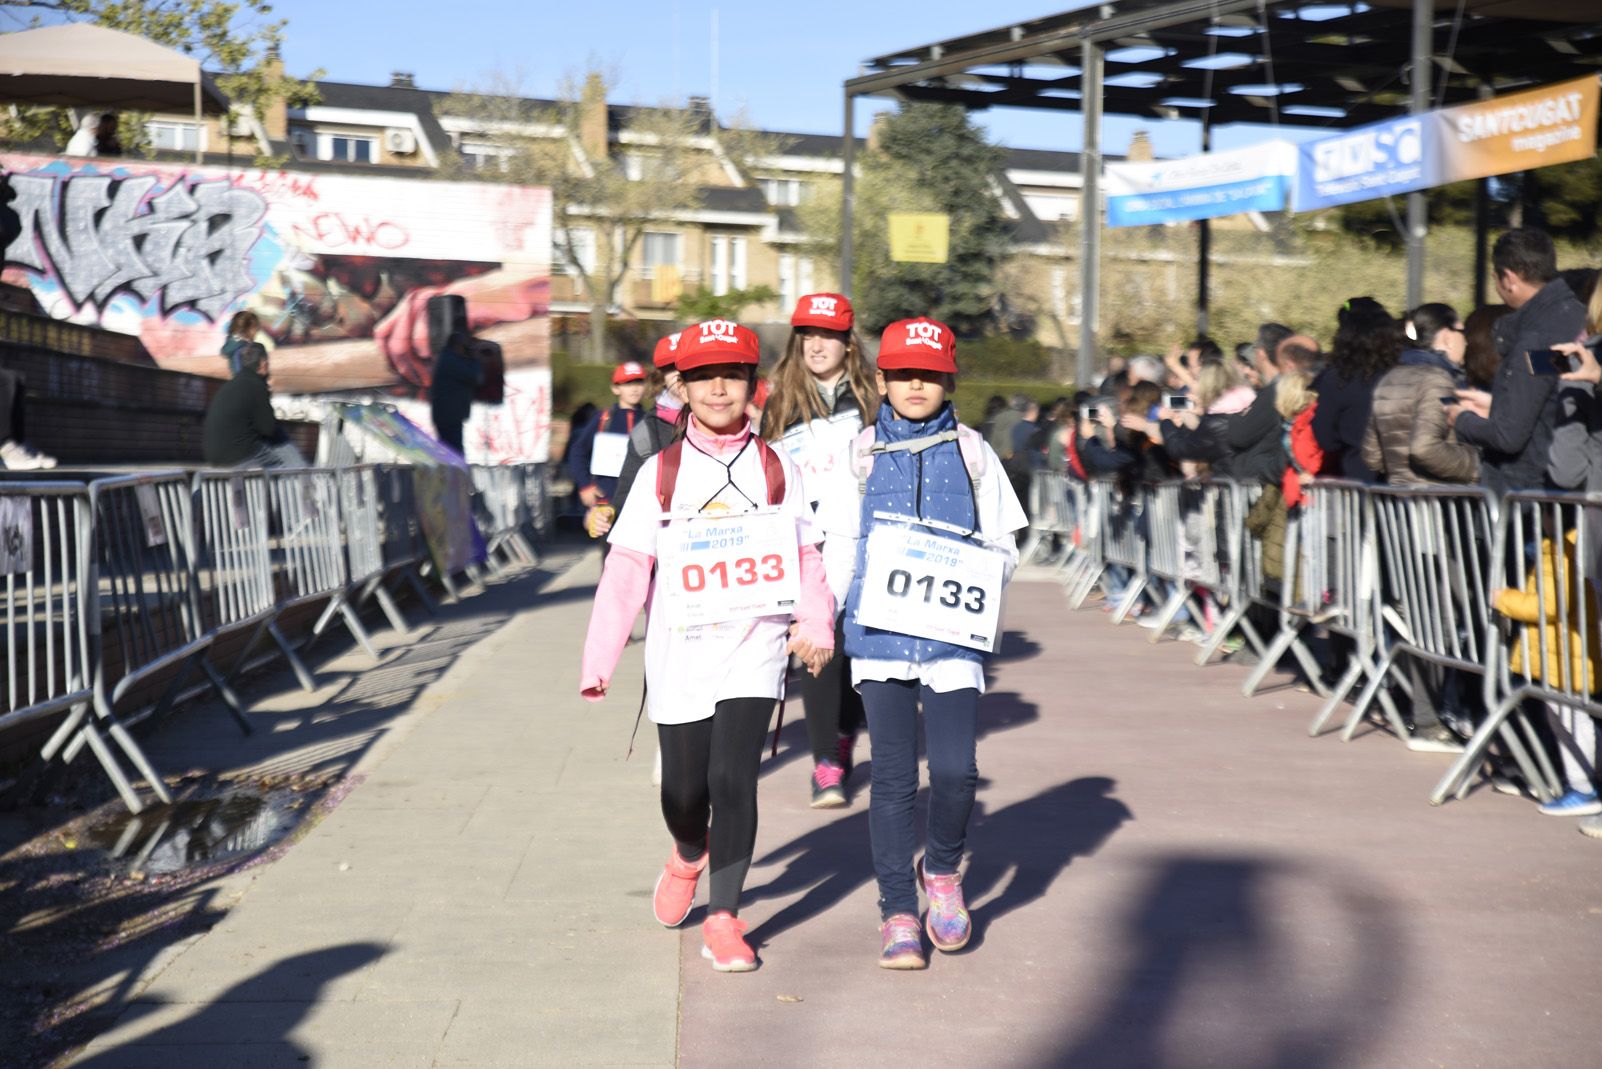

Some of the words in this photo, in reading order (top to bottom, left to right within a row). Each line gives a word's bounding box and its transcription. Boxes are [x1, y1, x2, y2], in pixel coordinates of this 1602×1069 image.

[811, 297, 838, 310] TOT
[699, 319, 738, 336] TOT
[905, 321, 942, 341] TOT
[705, 525, 743, 537] Marxa
[925, 538, 960, 555] Marxa
[681, 553, 786, 593] 0133
[886, 568, 987, 615] 0133
